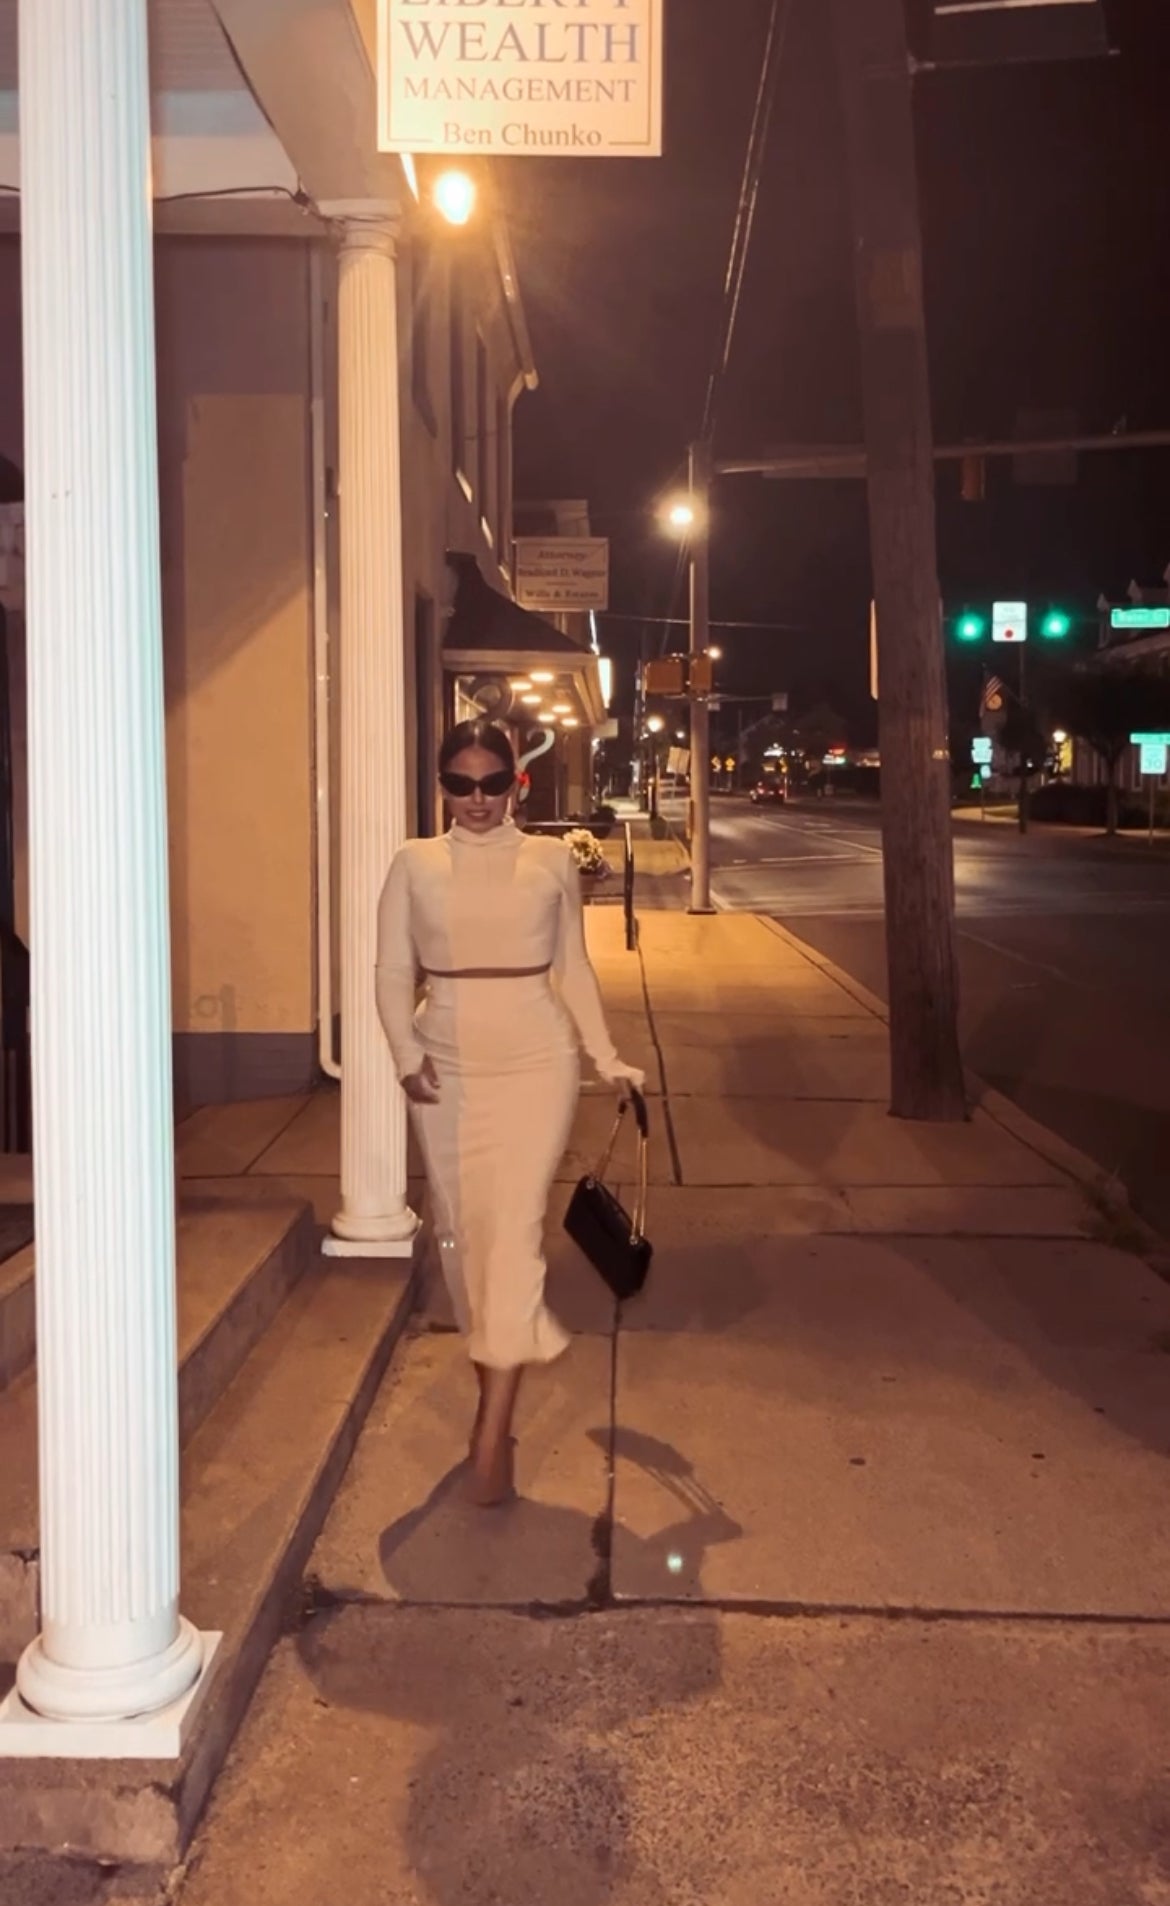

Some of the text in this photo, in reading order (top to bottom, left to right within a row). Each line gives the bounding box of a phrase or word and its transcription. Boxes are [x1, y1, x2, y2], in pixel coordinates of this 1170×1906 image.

[398, 20, 640, 63] WEALTH
[403, 77, 636, 102] MANAGEMENT
[443, 122, 602, 147] Ben Chunko
[537, 549, 587, 561] Attorney
[525, 589, 550, 598] Wills
[554, 589, 561, 598] &
